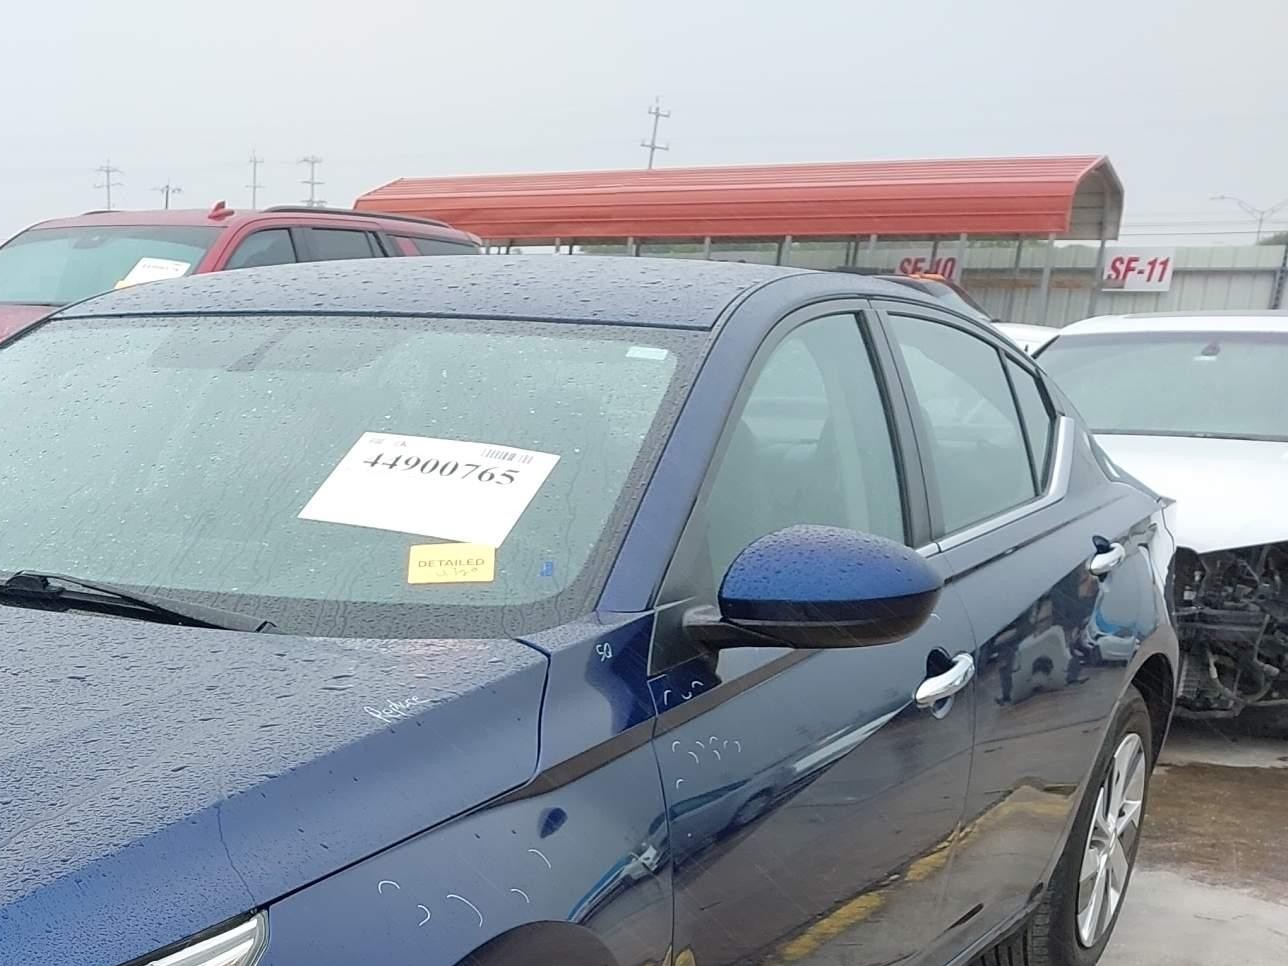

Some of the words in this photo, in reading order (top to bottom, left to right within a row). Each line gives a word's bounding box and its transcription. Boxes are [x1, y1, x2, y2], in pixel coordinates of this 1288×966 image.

[1109, 255, 1171, 283] SF-11
[363, 452, 521, 485] 44900765
[418, 558, 485, 568] DETAILED
